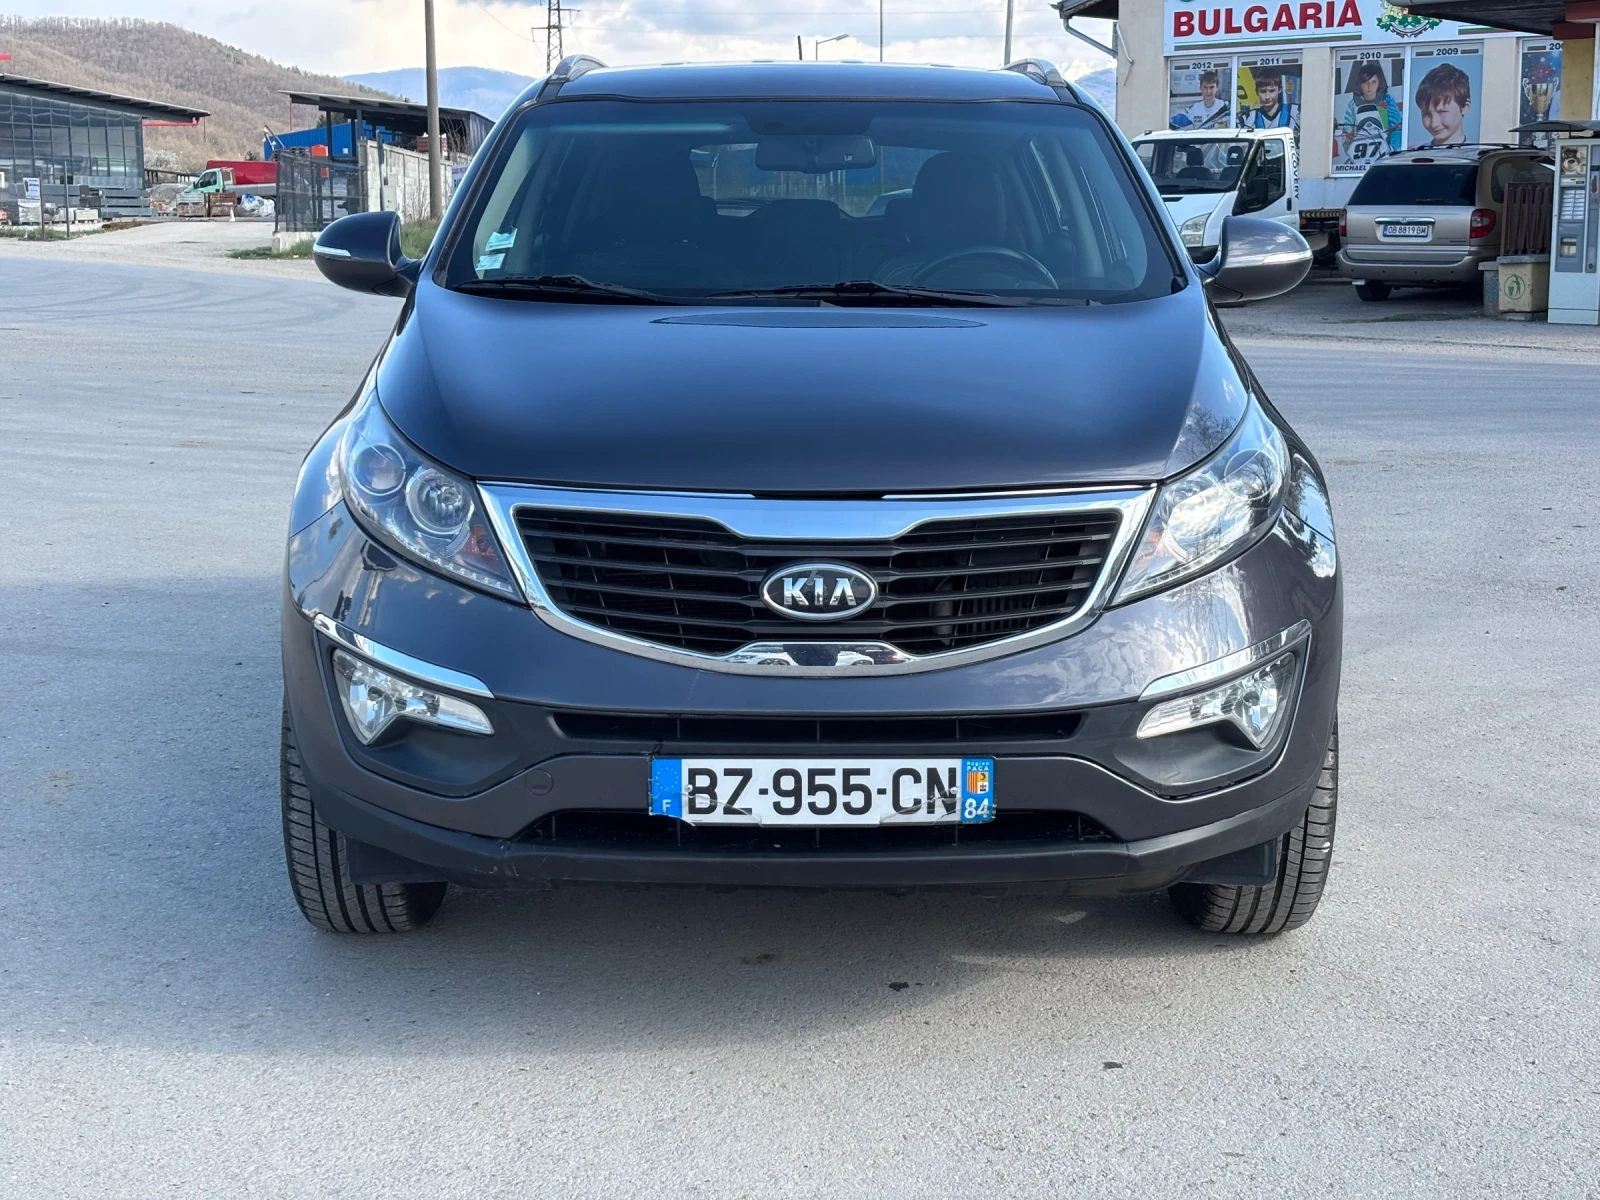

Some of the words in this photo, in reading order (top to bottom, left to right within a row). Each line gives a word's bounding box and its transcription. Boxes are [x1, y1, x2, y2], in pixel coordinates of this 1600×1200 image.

[1173, 0, 1362, 37] BULGARIA
[1436, 48, 1459, 56] 2009
[1549, 43, 1563, 51] 20
[1192, 62, 1211, 70] 2012
[1260, 58, 1280, 66] 2011
[1353, 142, 1382, 160] 97
[783, 578, 857, 606] KIA
[687, 768, 957, 815] BZ-955-CN
[662, 800, 671, 812] F
[964, 798, 990, 818] 84
